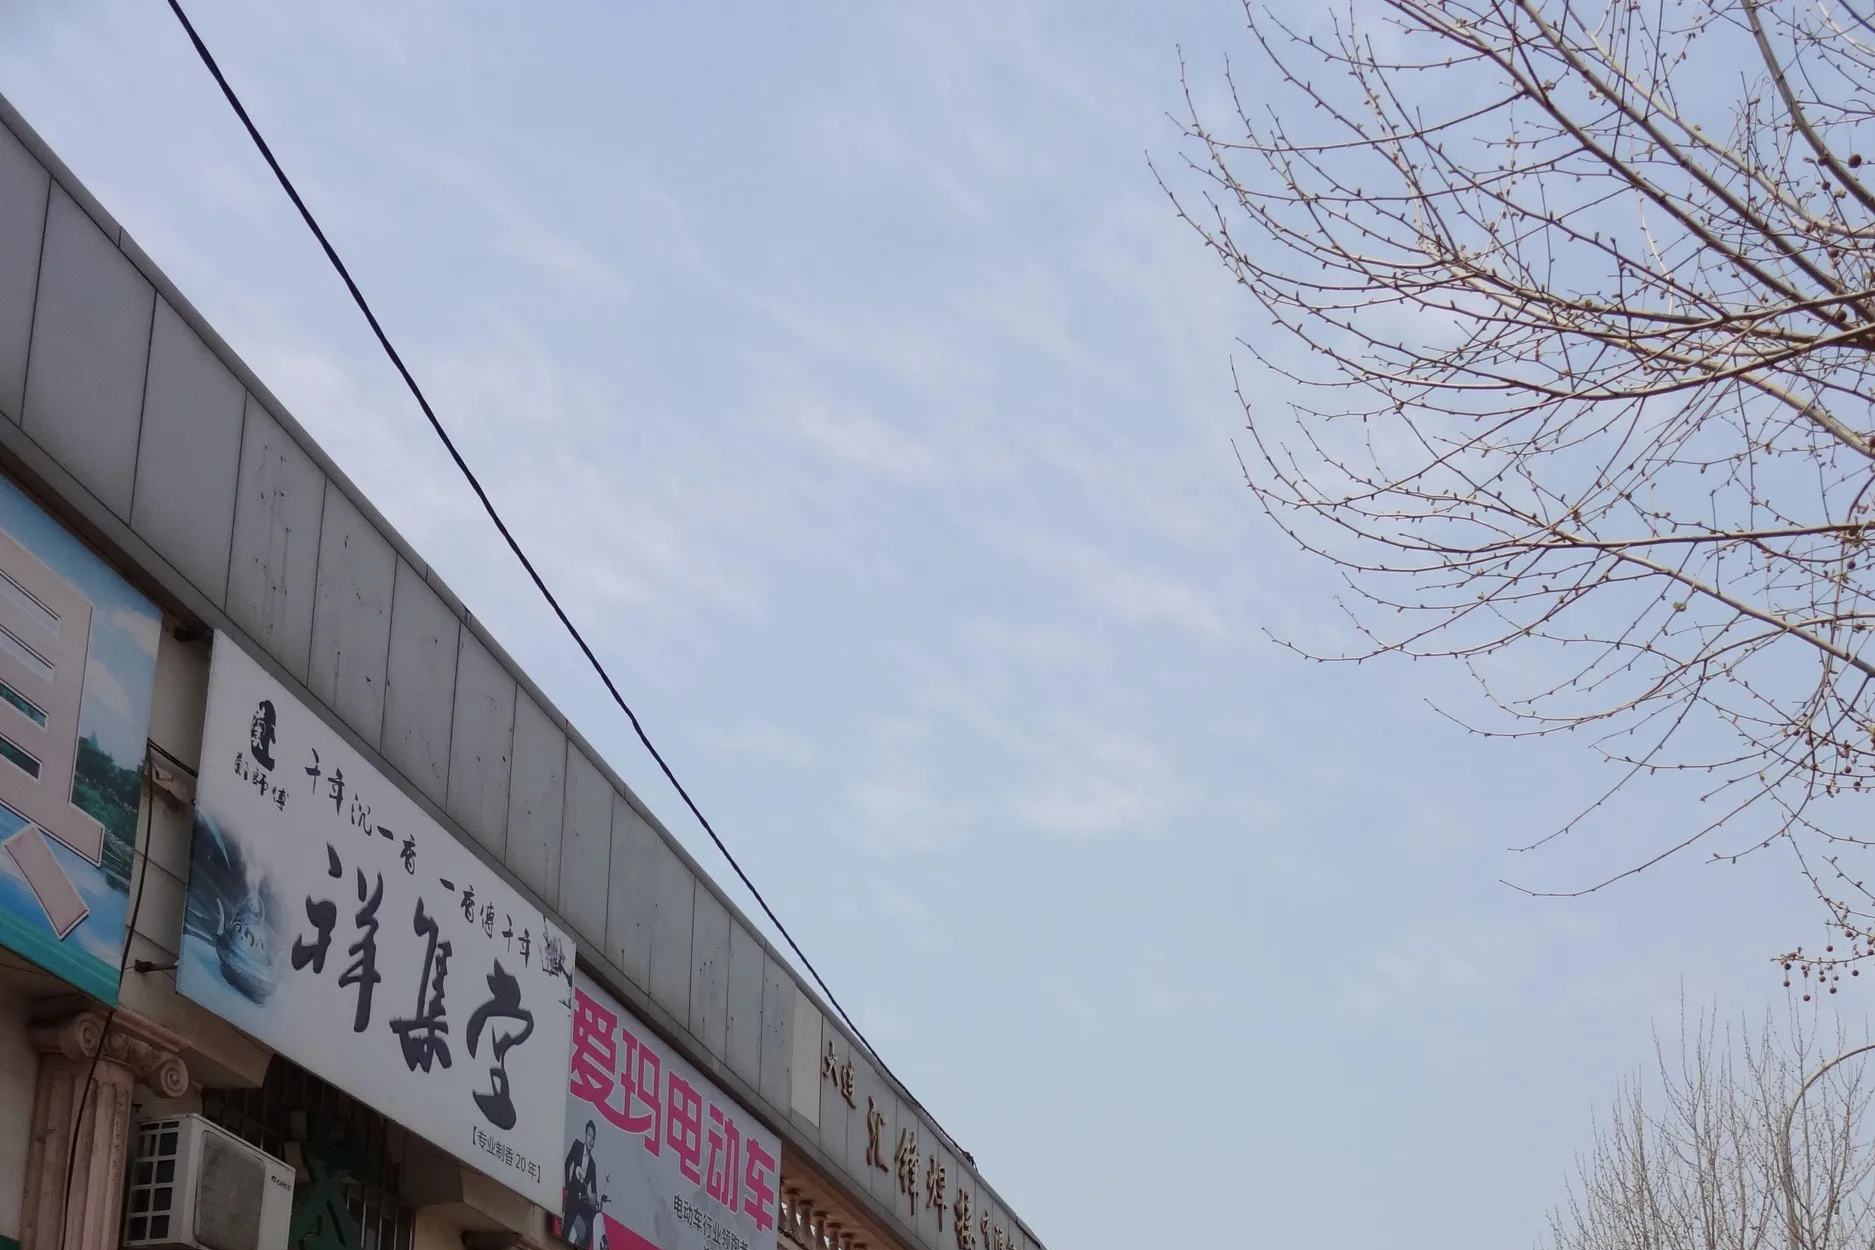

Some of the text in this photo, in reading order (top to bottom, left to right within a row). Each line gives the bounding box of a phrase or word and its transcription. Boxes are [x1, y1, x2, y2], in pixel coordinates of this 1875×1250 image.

[570, 986, 776, 1232] 爱玛电动车
